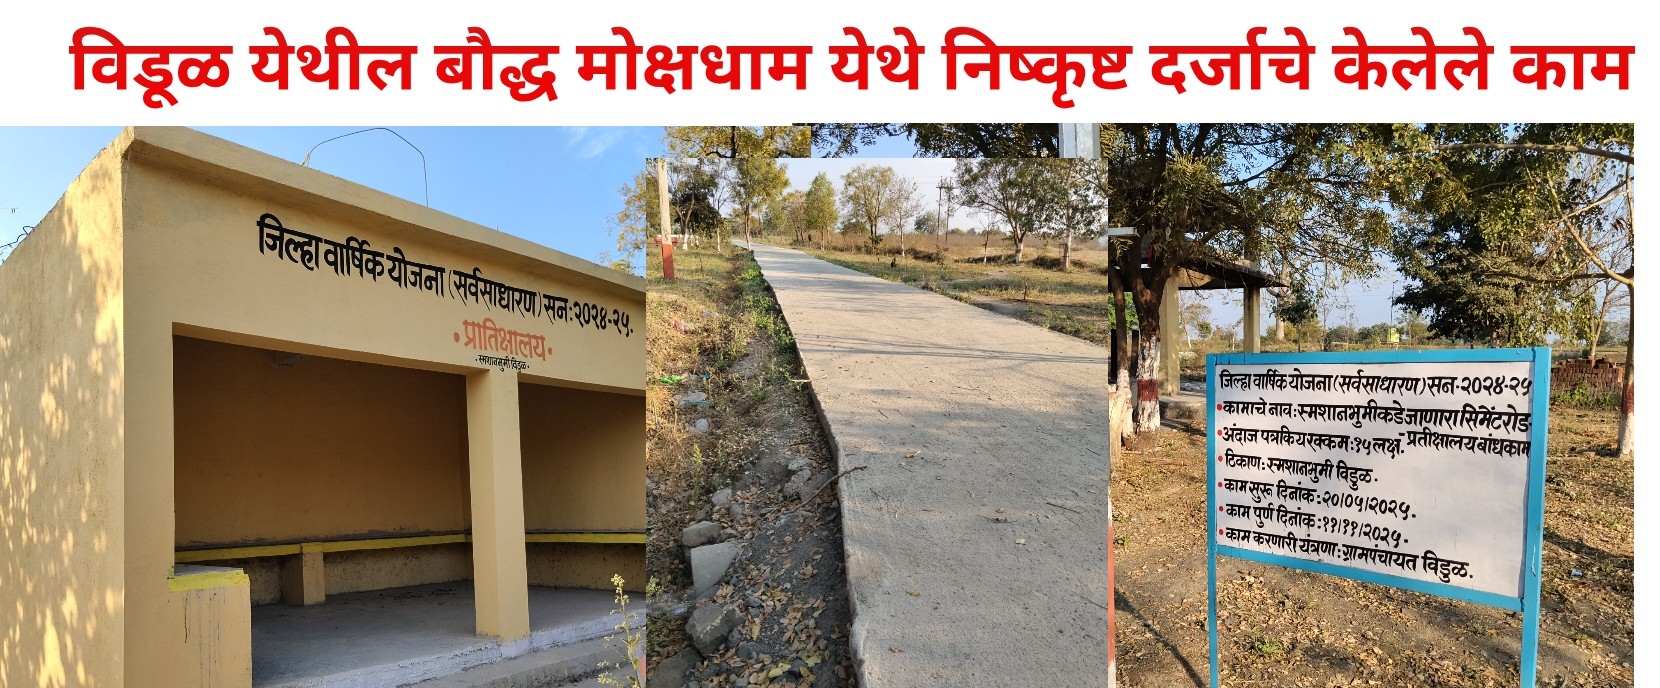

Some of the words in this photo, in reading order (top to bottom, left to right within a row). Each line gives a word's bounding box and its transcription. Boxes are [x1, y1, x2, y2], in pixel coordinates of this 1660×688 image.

[256, 212, 323, 271] जिल्हा
[323, 236, 385, 283] वार्षिक
[386, 246, 446, 298] योजना
[1219, 369, 1251, 391] जिल्हा
[1253, 369, 1287, 391] वार्षिक
[1288, 368, 1334, 392] योजना
[1223, 397, 1267, 417] कामाचे
[1405, 408, 1460, 430] जाणारा
[1222, 423, 1260, 446] अंदाज
[1224, 478, 1249, 494] काम
[1226, 503, 1251, 520] काम
[1226, 527, 1251, 544] काम
[1252, 531, 1298, 553] करणारी
